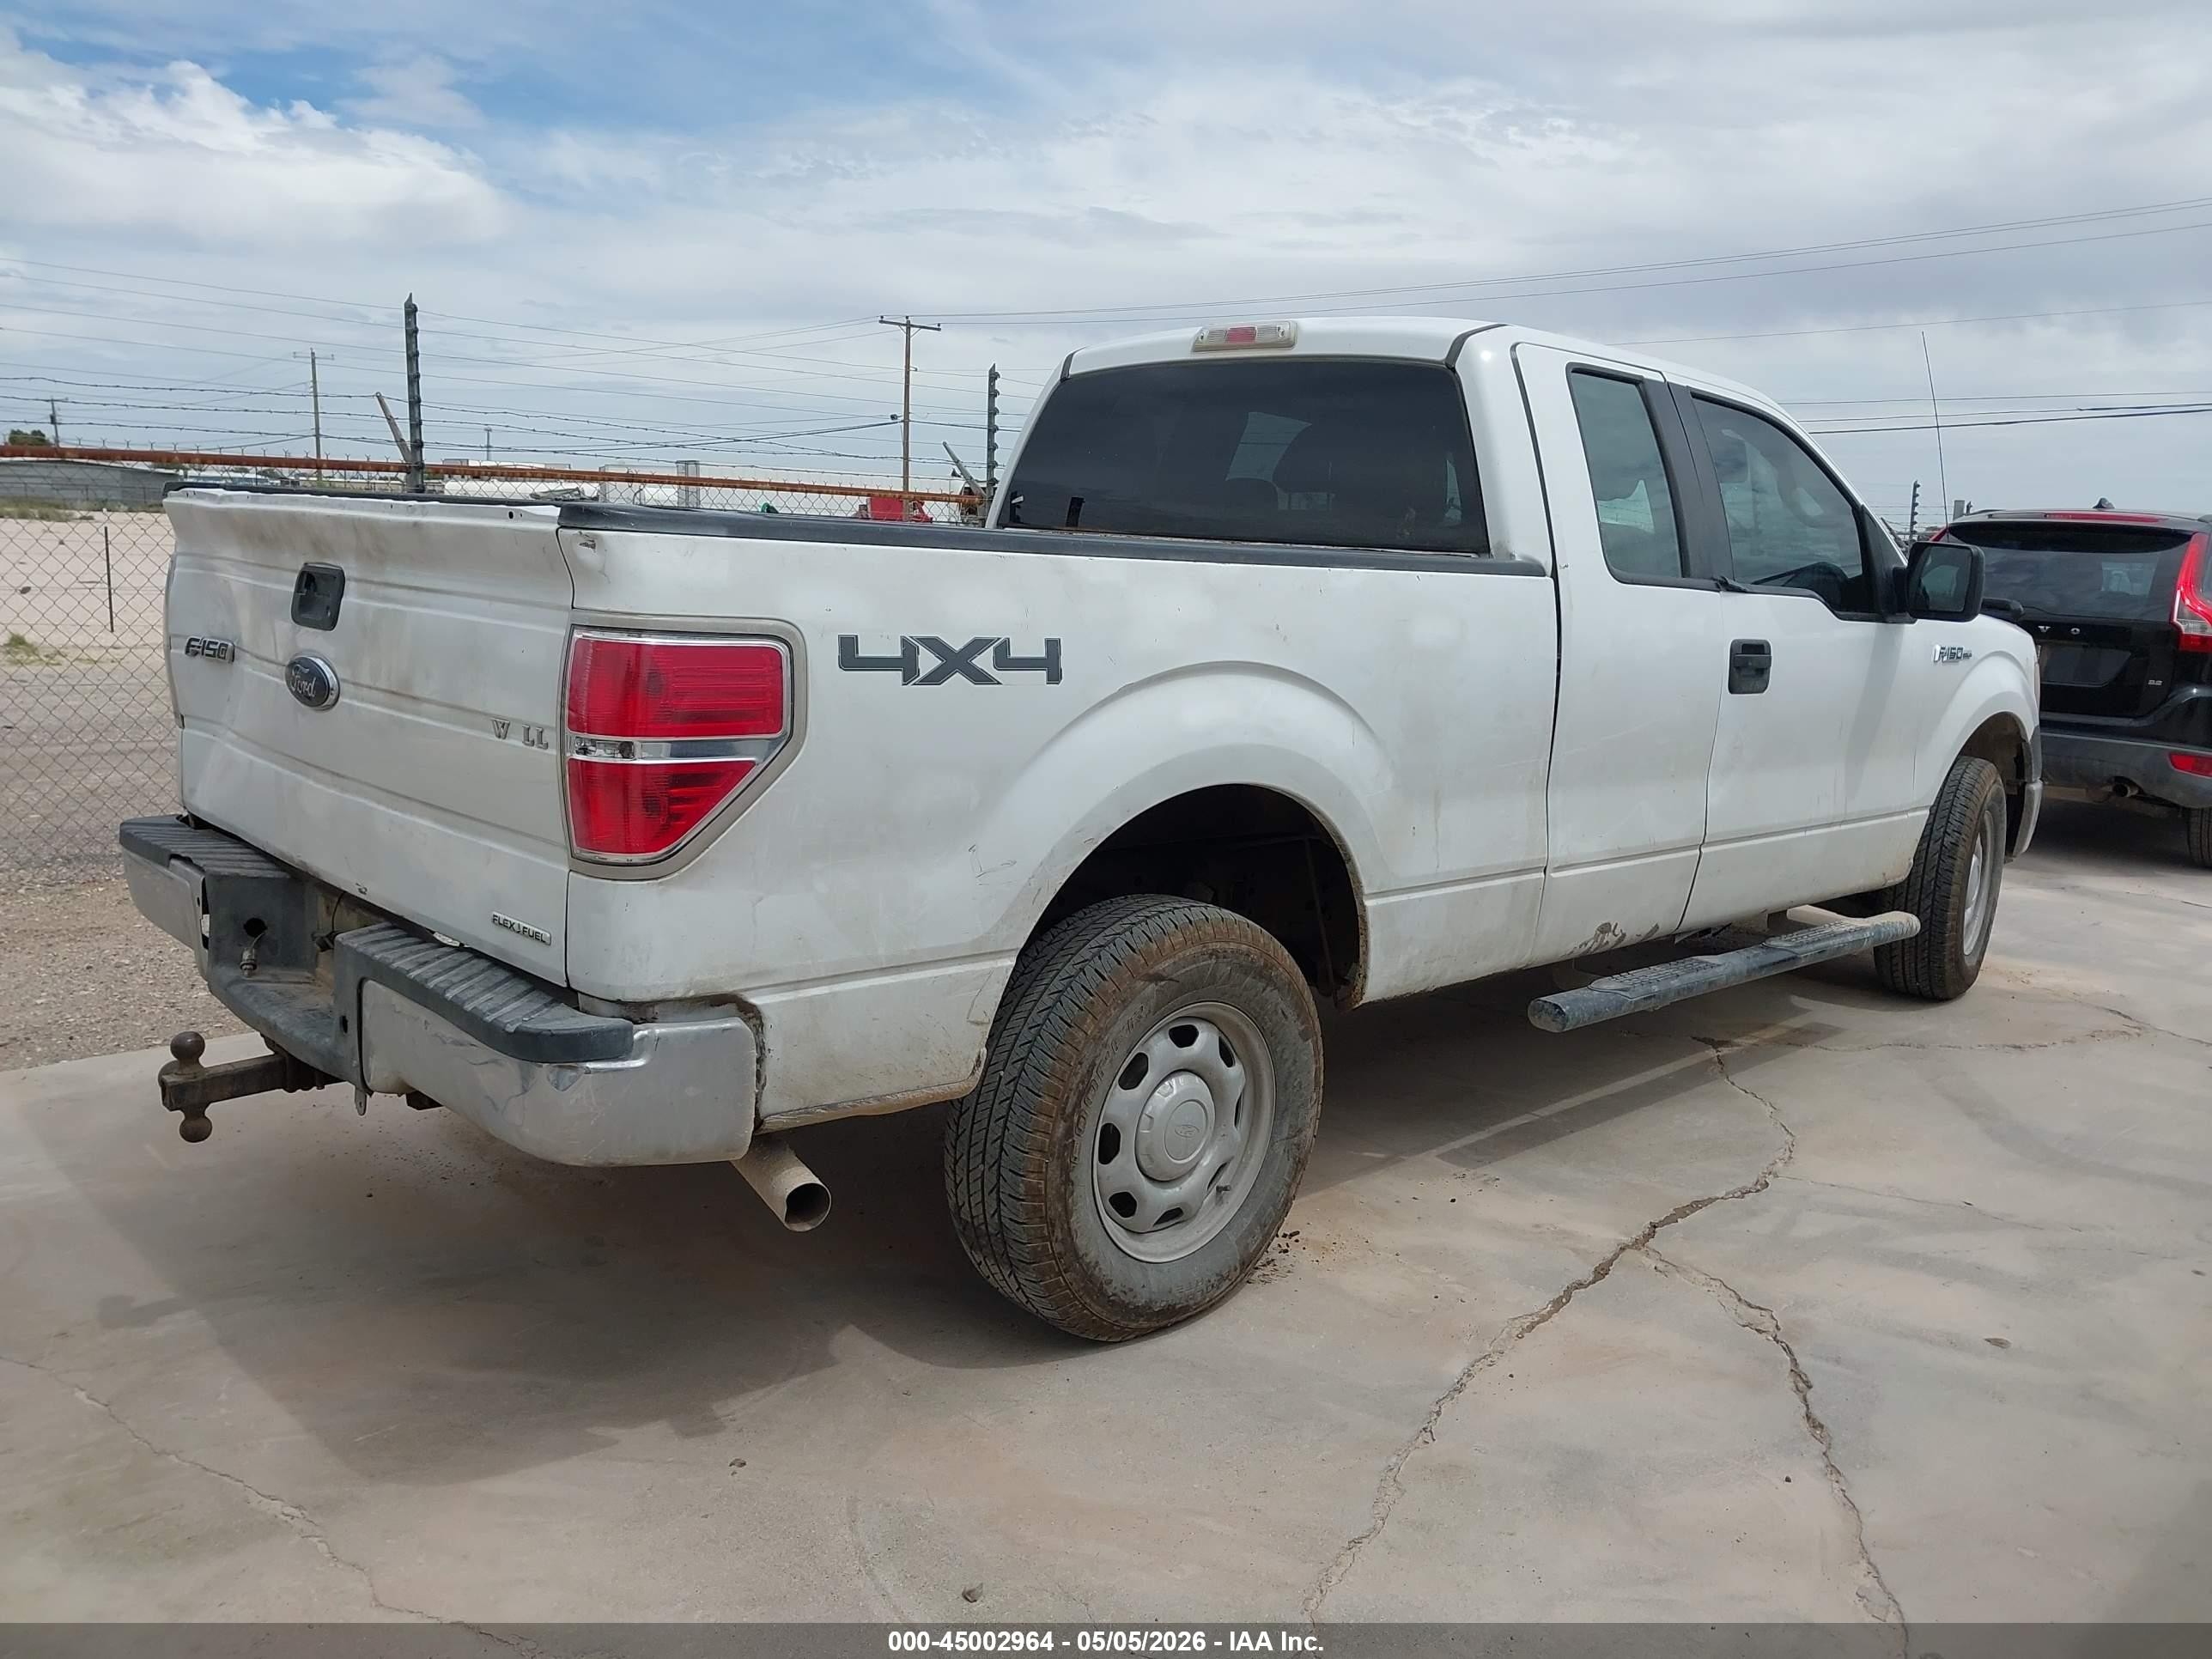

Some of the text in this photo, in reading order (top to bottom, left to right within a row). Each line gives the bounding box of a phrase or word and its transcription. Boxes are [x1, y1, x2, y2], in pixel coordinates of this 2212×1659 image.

[185, 636, 230, 662] F-150
[838, 635, 1063, 685] 4X4
[492, 914, 547, 943] FLEX FUEL
